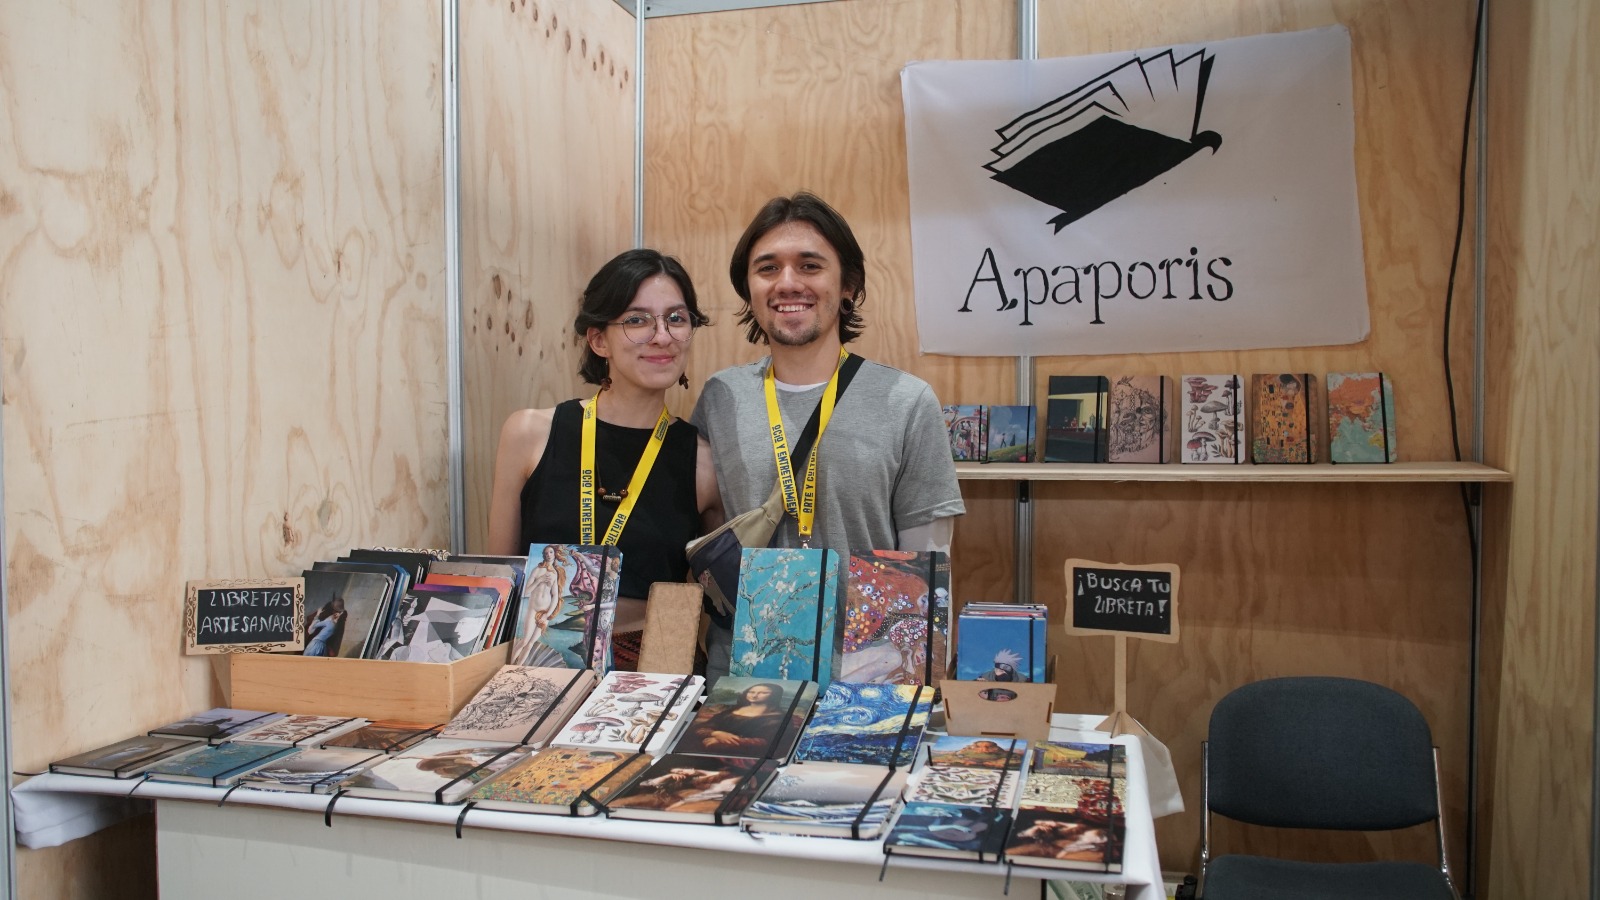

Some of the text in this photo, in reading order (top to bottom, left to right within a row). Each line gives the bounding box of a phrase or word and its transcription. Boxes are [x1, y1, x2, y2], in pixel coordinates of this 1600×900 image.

[958, 247, 1233, 325] Apaporis
[803, 492, 813, 513] ARTE
[1077, 572, 1170, 595] ¡BUSCA TU
[210, 590, 292, 607] LIBRETAS
[199, 614, 294, 634] ARTESANALES
